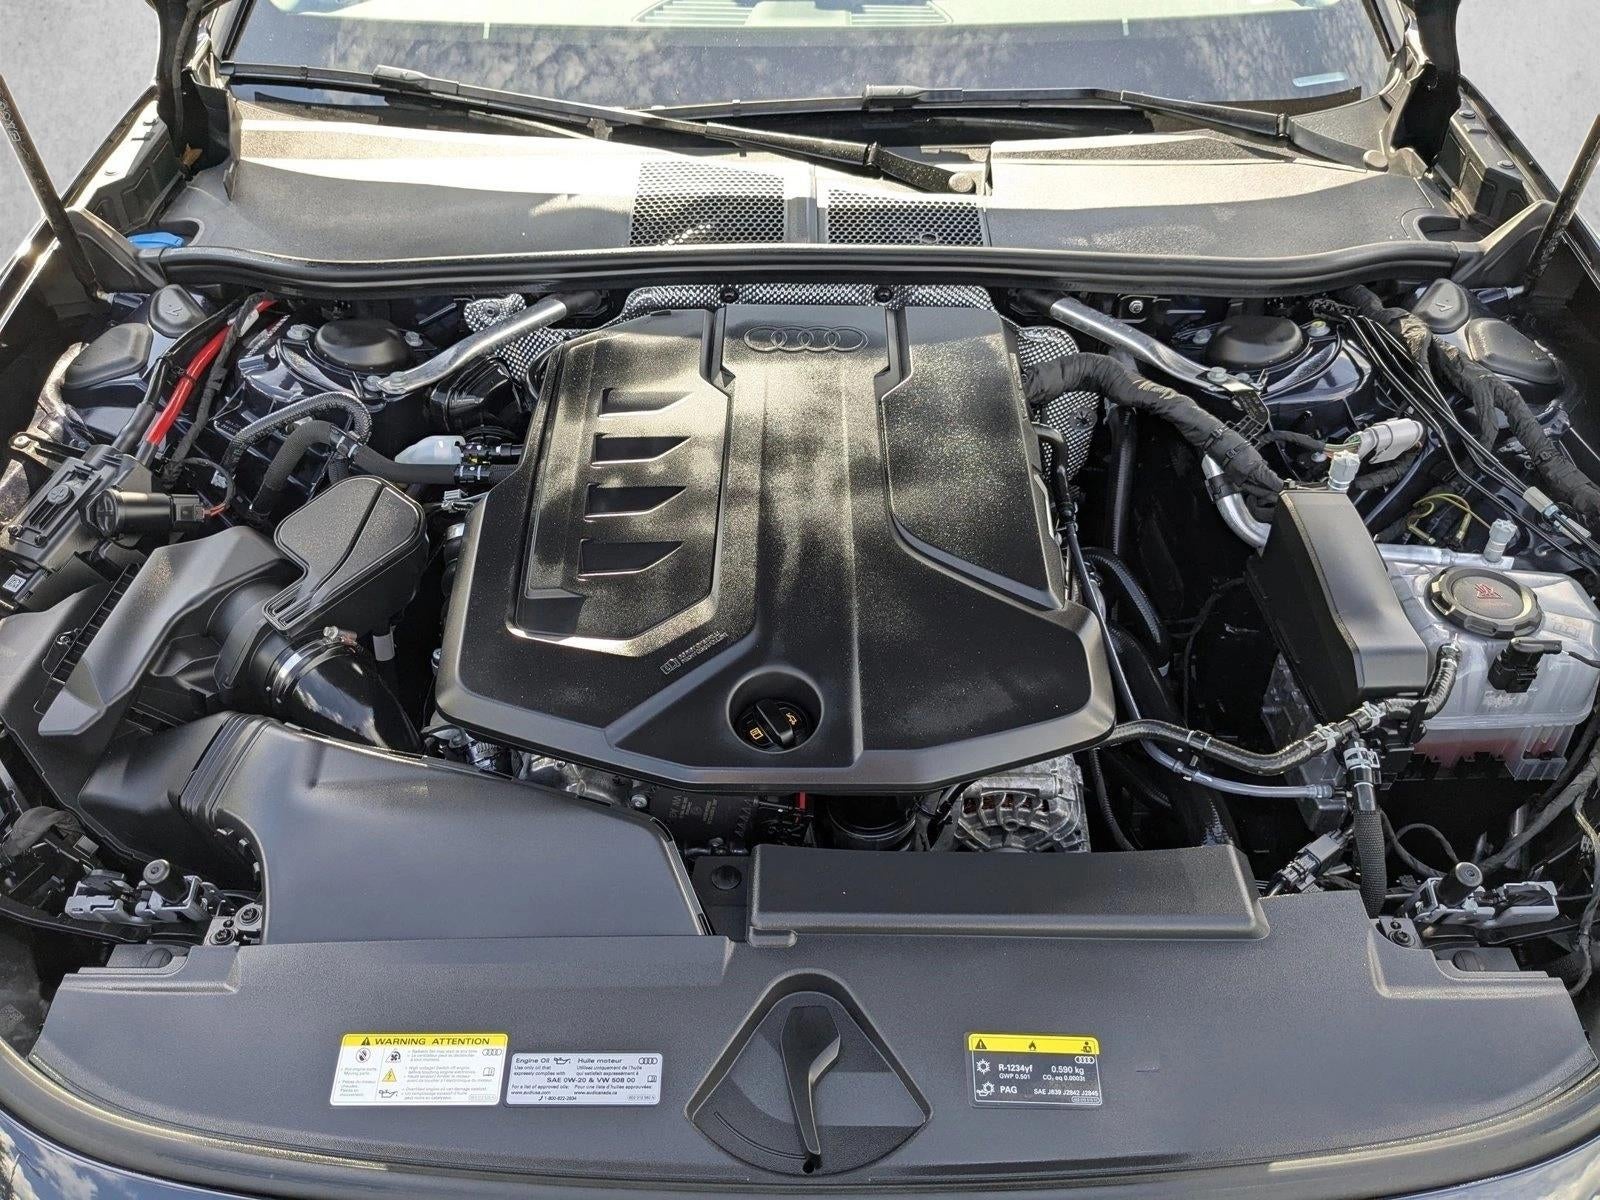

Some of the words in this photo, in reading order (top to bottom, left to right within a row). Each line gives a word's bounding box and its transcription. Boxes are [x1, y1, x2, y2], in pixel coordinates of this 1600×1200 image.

[374, 1037, 426, 1046] WARNING
[431, 1037, 490, 1046] ATTENTION
[998, 1064, 1033, 1073] R-1234yf
[1051, 1065, 1073, 1074] 0.590
[1074, 1066, 1085, 1075] kg
[1000, 1085, 1018, 1094] PAG
